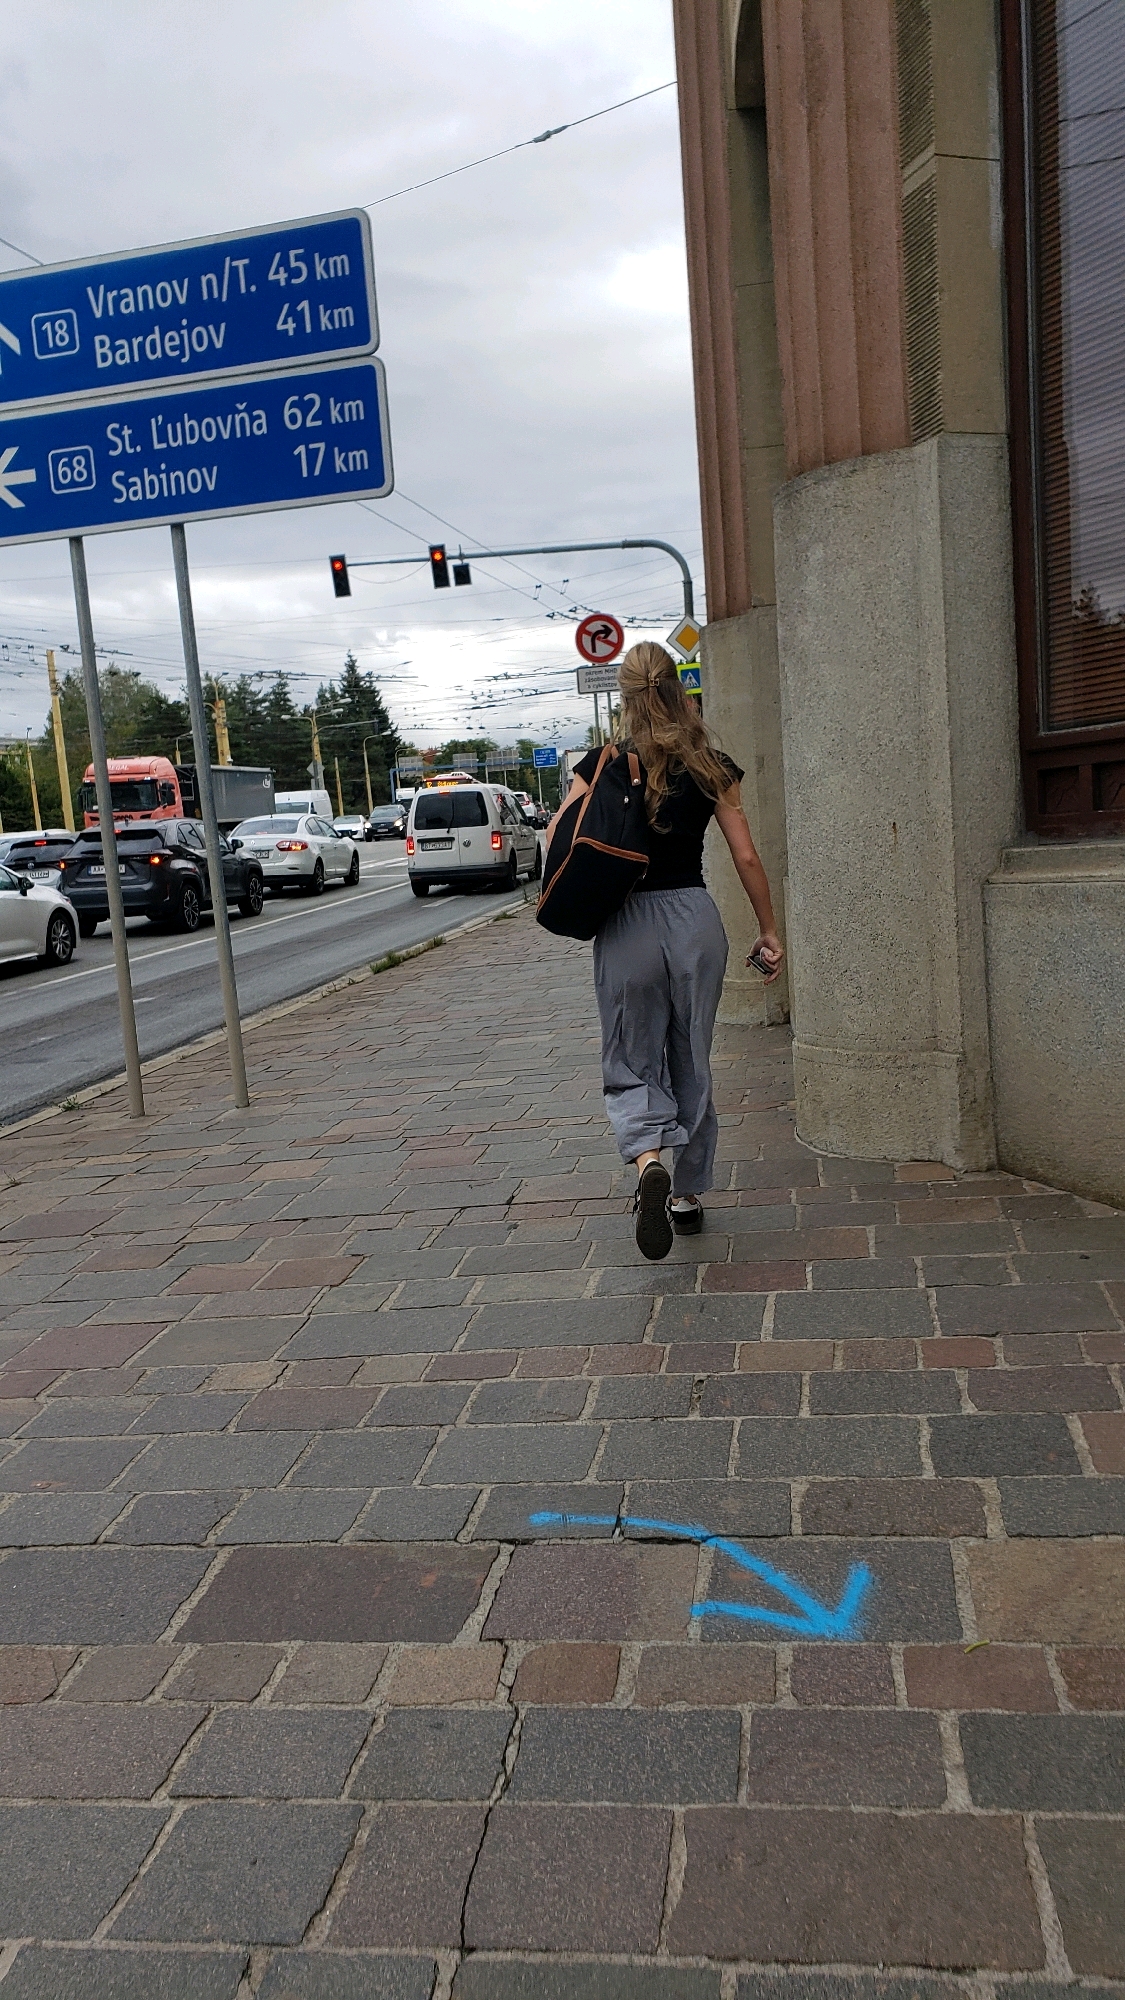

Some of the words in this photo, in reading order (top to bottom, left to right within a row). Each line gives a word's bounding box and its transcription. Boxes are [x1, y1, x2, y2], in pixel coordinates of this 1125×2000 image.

[86, 276, 189, 318] Vranov
[201, 256, 256, 302] n/T.
[268, 248, 308, 286] 45
[314, 252, 349, 280] km
[40, 318, 70, 349] 18
[94, 319, 227, 369] Bardejov
[276, 300, 312, 336] 41
[319, 304, 354, 331] km
[106, 423, 141, 456] St.
[151, 402, 267, 450] Ľubovňa
[283, 393, 322, 430] 62
[329, 397, 365, 424] km
[57, 455, 88, 484] 68
[111, 464, 218, 504] Sabinov
[293, 442, 326, 478] 17
[334, 447, 368, 473] km
